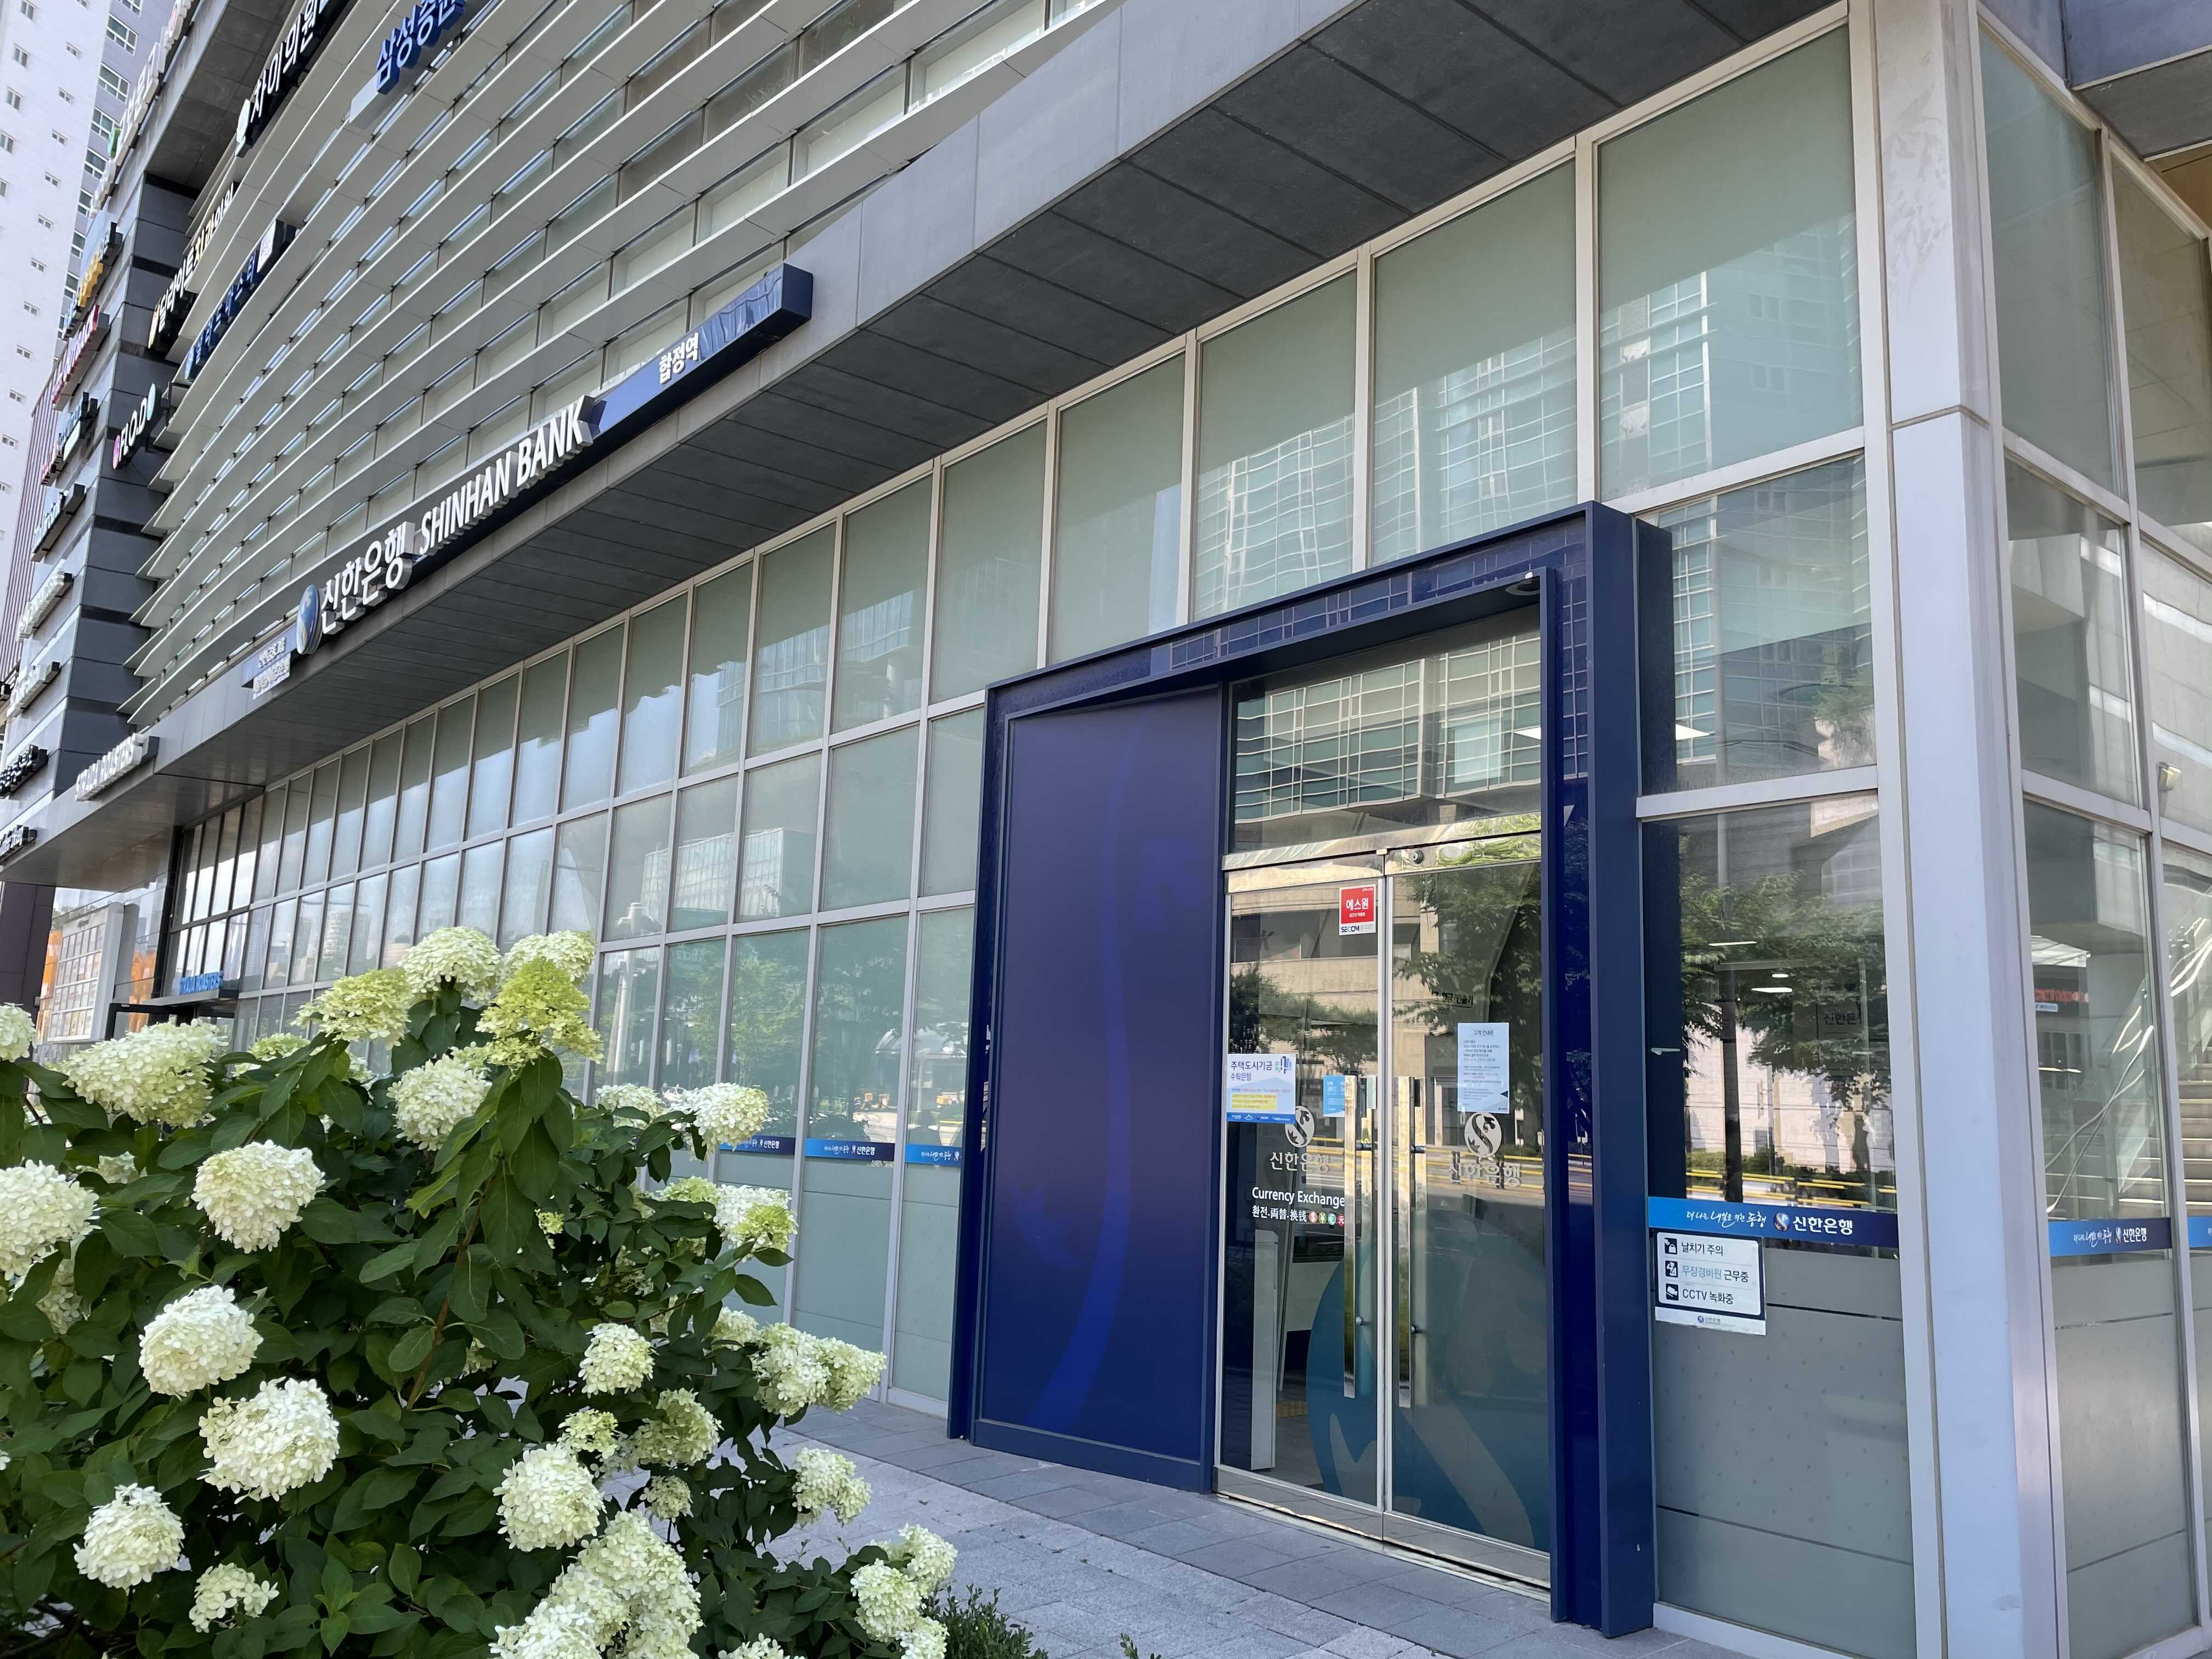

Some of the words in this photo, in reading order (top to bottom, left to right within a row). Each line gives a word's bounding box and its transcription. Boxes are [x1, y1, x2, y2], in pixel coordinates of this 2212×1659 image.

[658, 331, 699, 384] 합정역
[321, 528, 406, 634] 신한은행
[419, 451, 511, 555] SHINHAN
[516, 395, 588, 487] BANK
[1346, 898, 1369, 911] 에스원
[1231, 1062, 1272, 1070] 주택도시기금
[1231, 1073, 1251, 1081] 수탁은행
[857, 1146, 875, 1155] 신한은행
[1270, 1152, 1331, 1173] 신한은행
[1448, 1161, 1520, 1187] 신한은행
[1252, 1187, 1295, 1205] Currency
[1297, 1190, 1345, 1209] Exchange
[1686, 1211, 1695, 1221] 더
[1696, 1212, 1709, 1220] 나은
[1711, 1211, 1736, 1228] 내일을
[1734, 1212, 1746, 1222] 위한
[1747, 1211, 1767, 1227] 동행
[1792, 1216, 1853, 1235] 신한은행
[2123, 1227, 2147, 1243] 신한은행
[1681, 1242, 1705, 1254] 날치기
[1707, 1245, 1723, 1256] 주의
[1682, 1265, 1722, 1279] 무장경비원
[1724, 1269, 1749, 1282] 근무중
[1683, 1289, 1707, 1300] CCTV
[1709, 1291, 1734, 1305] 녹화중
